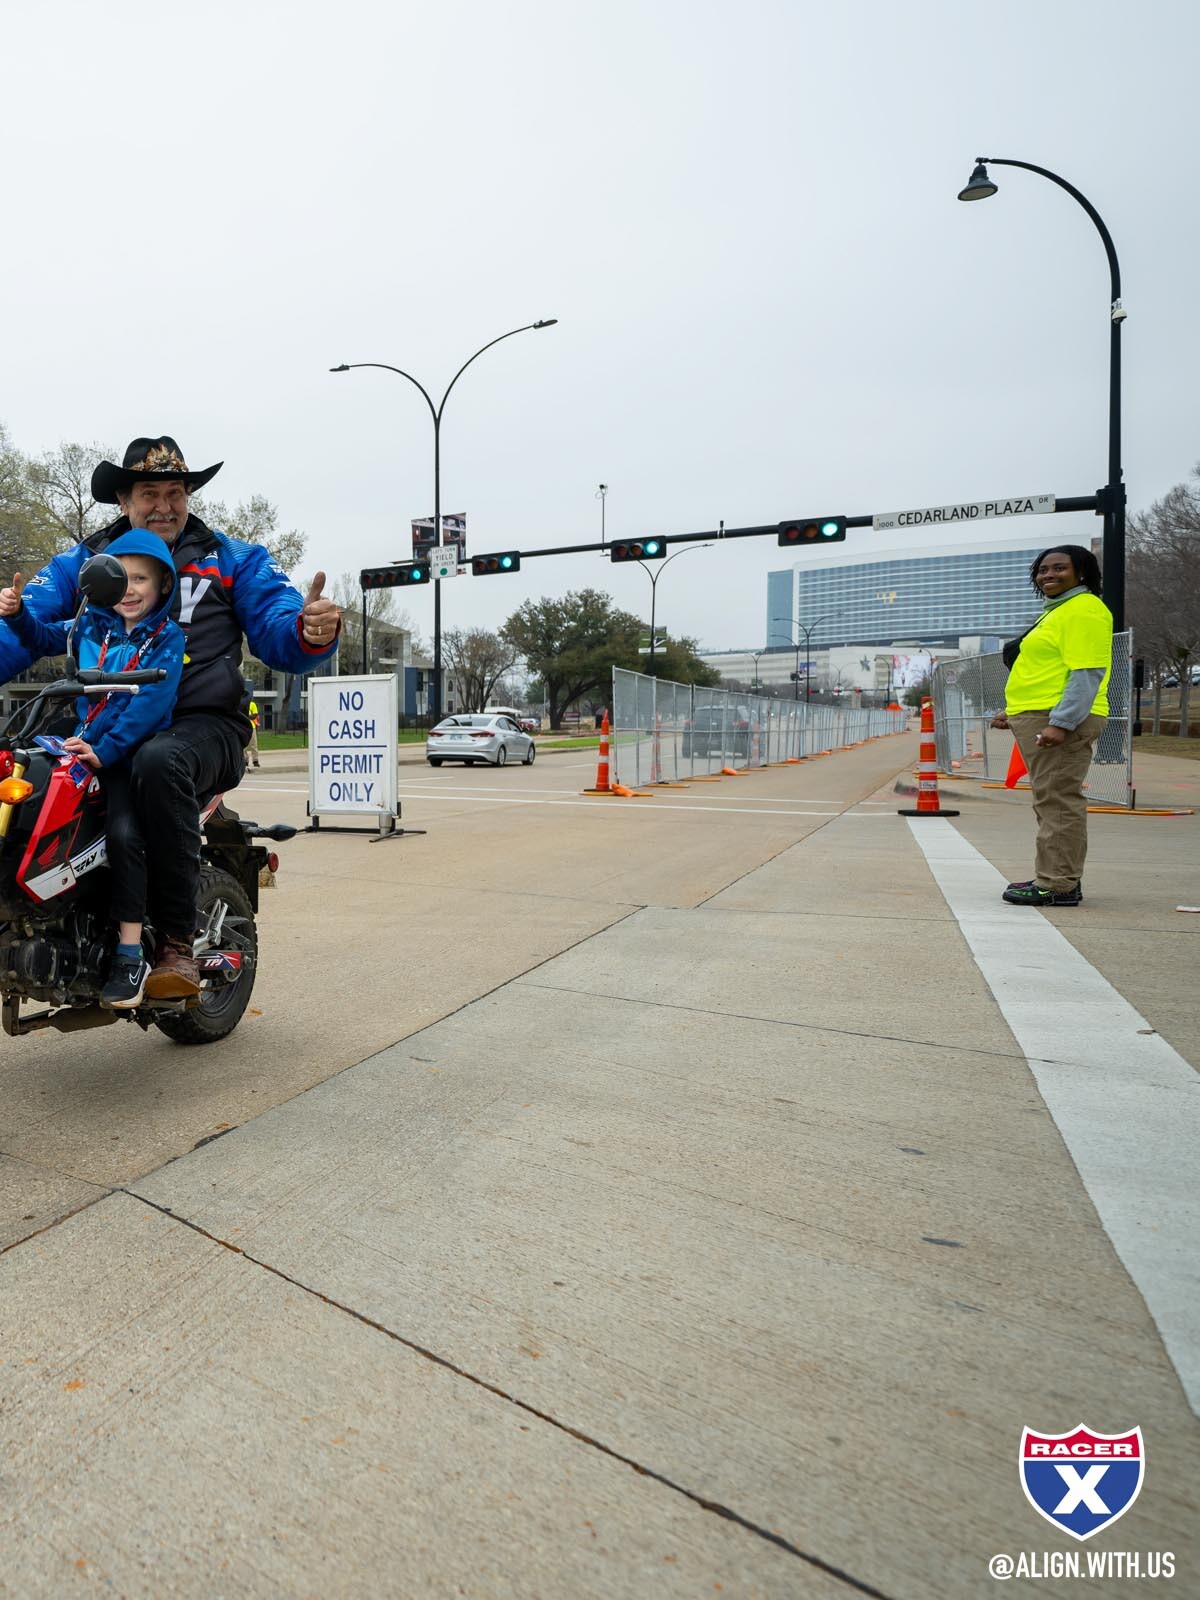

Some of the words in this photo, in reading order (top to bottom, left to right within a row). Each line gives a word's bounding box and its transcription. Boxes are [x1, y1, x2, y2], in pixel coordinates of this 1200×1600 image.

[897, 505, 979, 526] CEDARLAND
[985, 499, 1034, 516] PLAZA
[435, 553, 453, 561] YIELD
[339, 691, 364, 711] NO
[328, 719, 376, 740] CASH
[320, 754, 384, 774] PERMIT
[329, 782, 374, 803] ONLY
[73, 851, 98, 873] FLY
